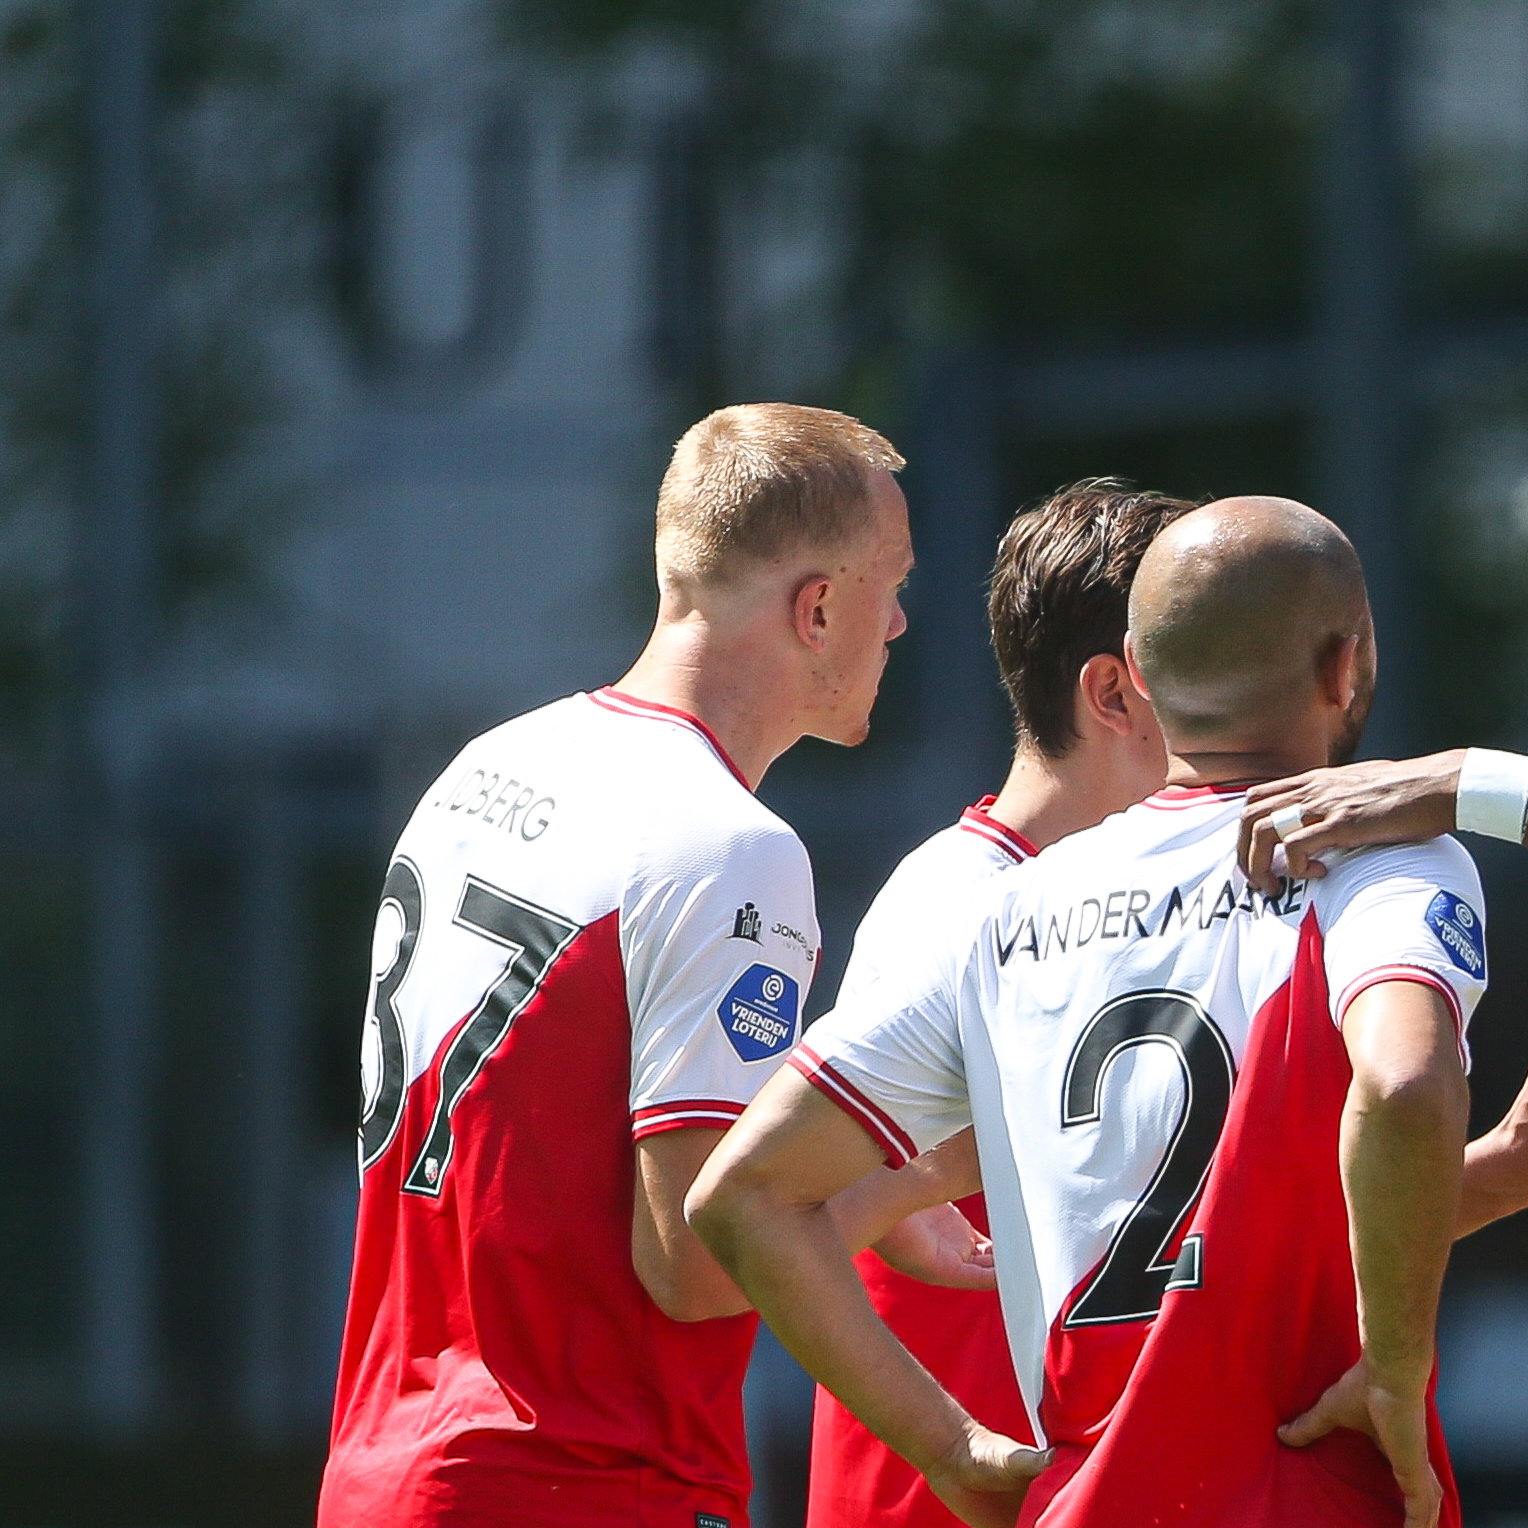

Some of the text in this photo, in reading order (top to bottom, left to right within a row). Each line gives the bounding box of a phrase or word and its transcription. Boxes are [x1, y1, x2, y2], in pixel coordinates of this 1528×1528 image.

[360, 854, 586, 1196] 37
[731, 1002, 789, 1040] VRIENDEN
[731, 1021, 778, 1049] LOTERIJ
[1060, 988, 1237, 1331] 2
